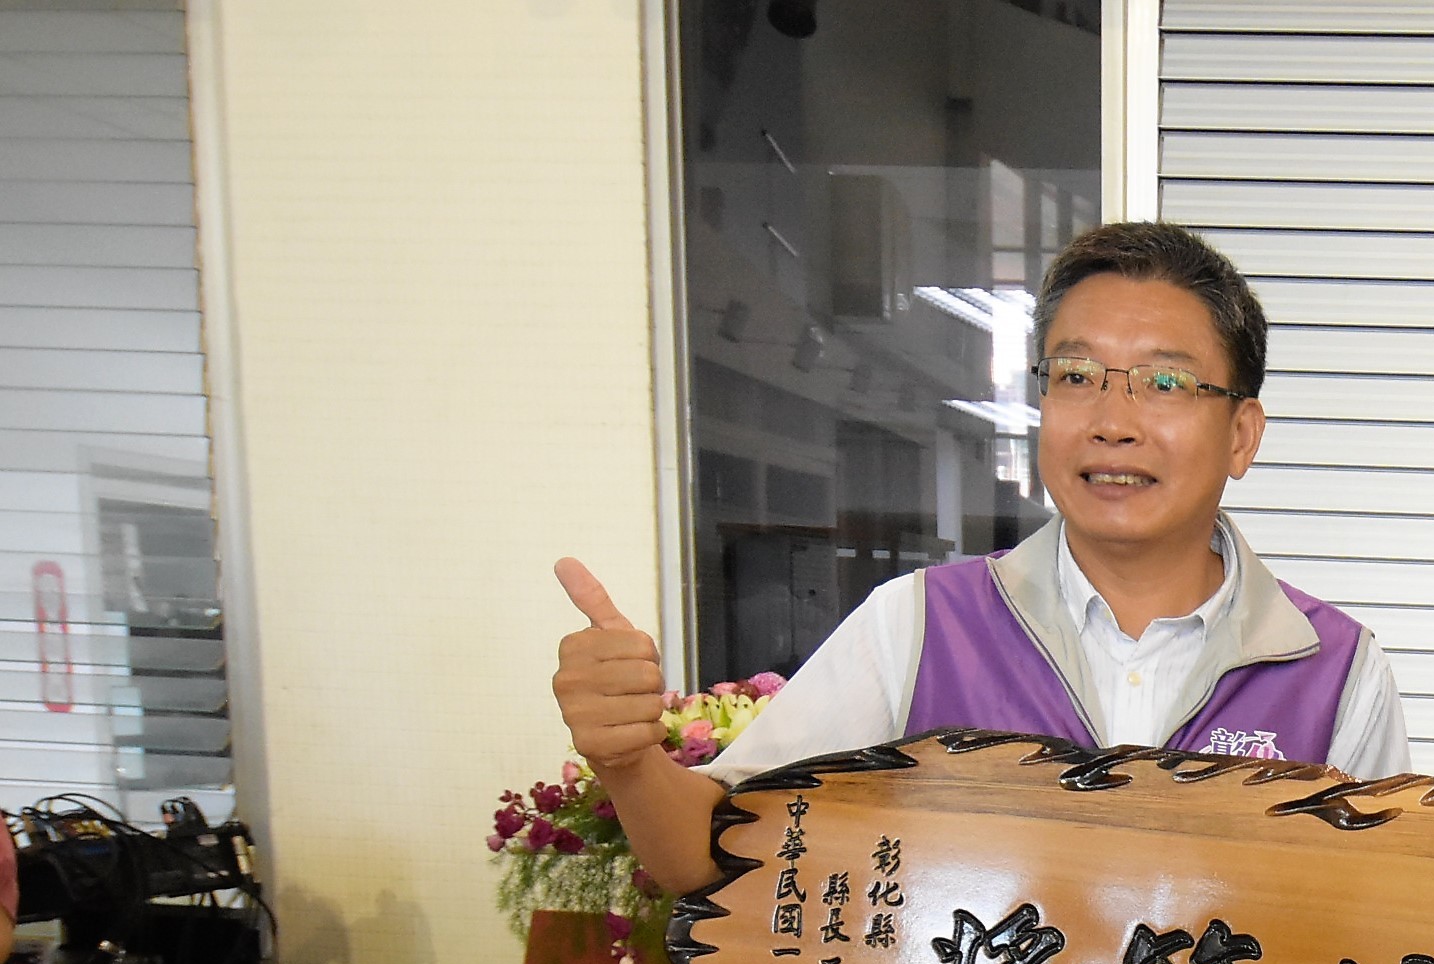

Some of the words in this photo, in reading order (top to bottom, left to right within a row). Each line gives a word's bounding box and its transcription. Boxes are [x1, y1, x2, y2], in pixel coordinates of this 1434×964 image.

[819, 872, 851, 943] 縣長
[865, 834, 905, 928] 彰化縣
